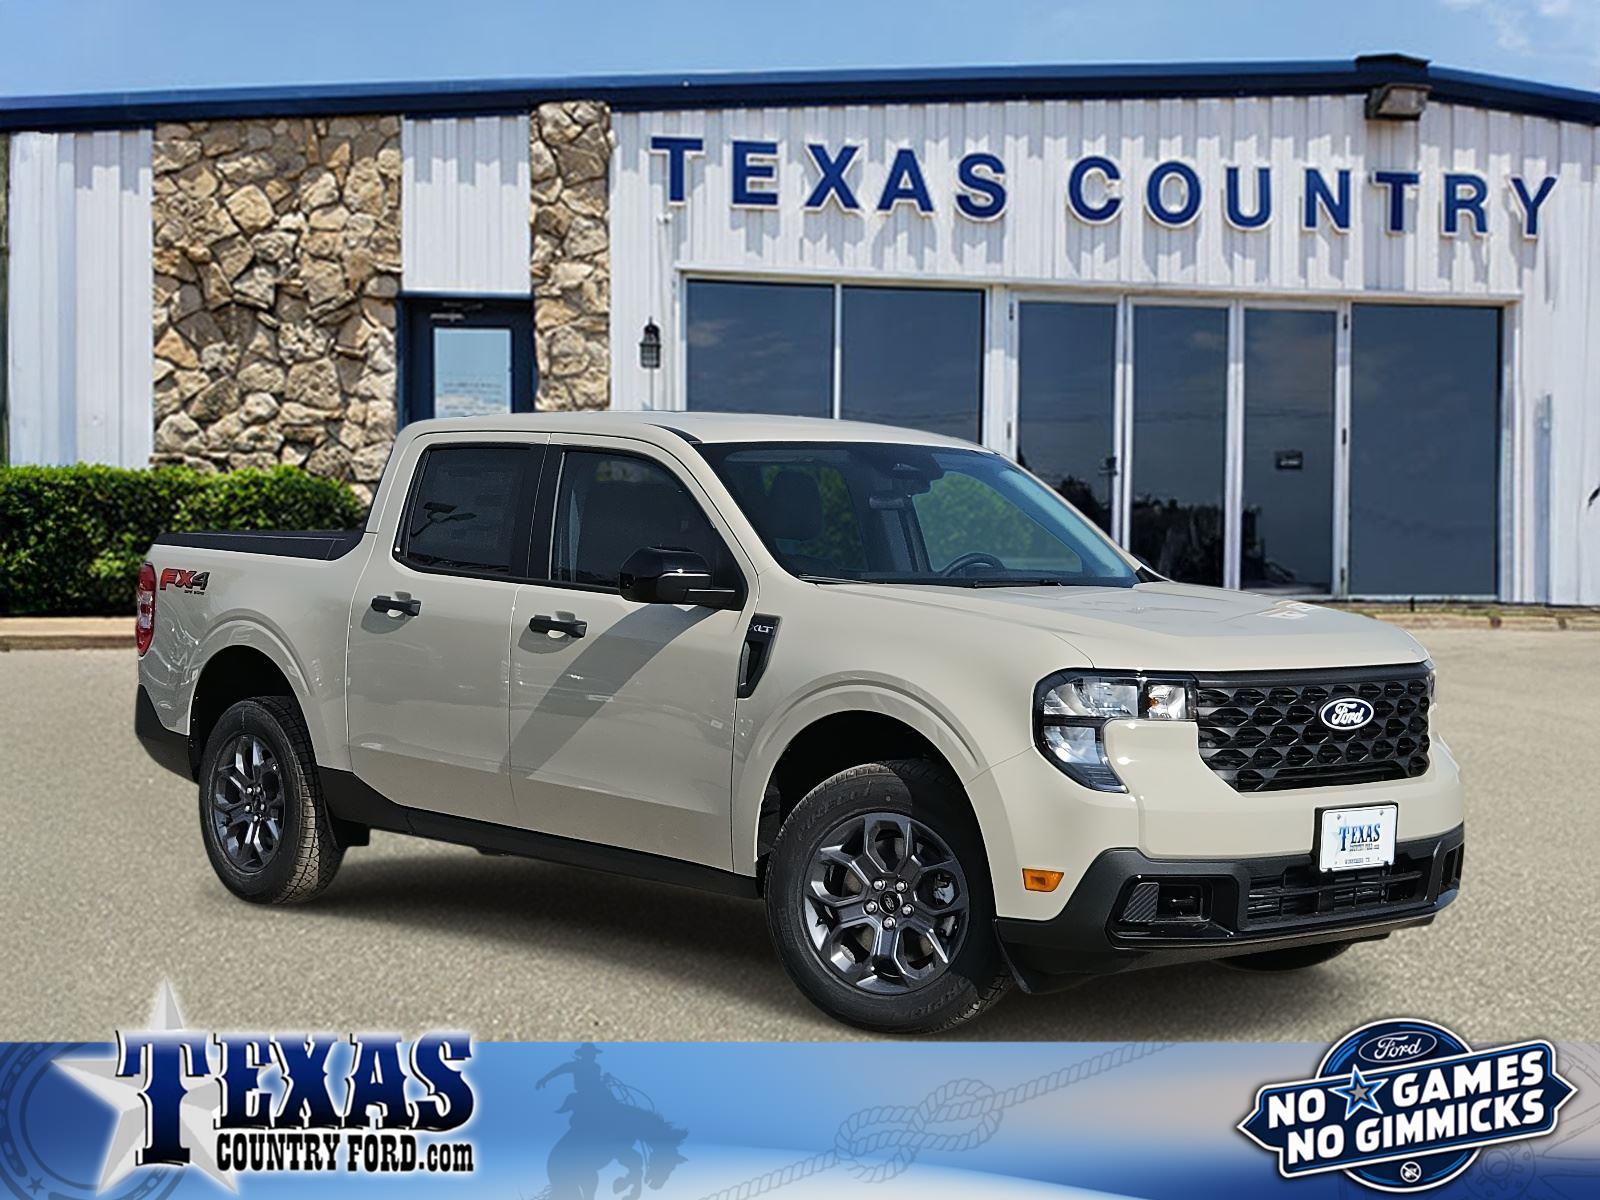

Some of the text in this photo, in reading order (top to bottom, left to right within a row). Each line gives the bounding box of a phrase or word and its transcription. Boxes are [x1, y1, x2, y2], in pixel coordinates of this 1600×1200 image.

[650, 136, 1557, 239] TEXAS COUNTRY
[160, 568, 210, 590] FX4
[750, 624, 774, 633] XLT
[1331, 702, 1365, 725] Ford
[1338, 822, 1381, 852] TEXAS
